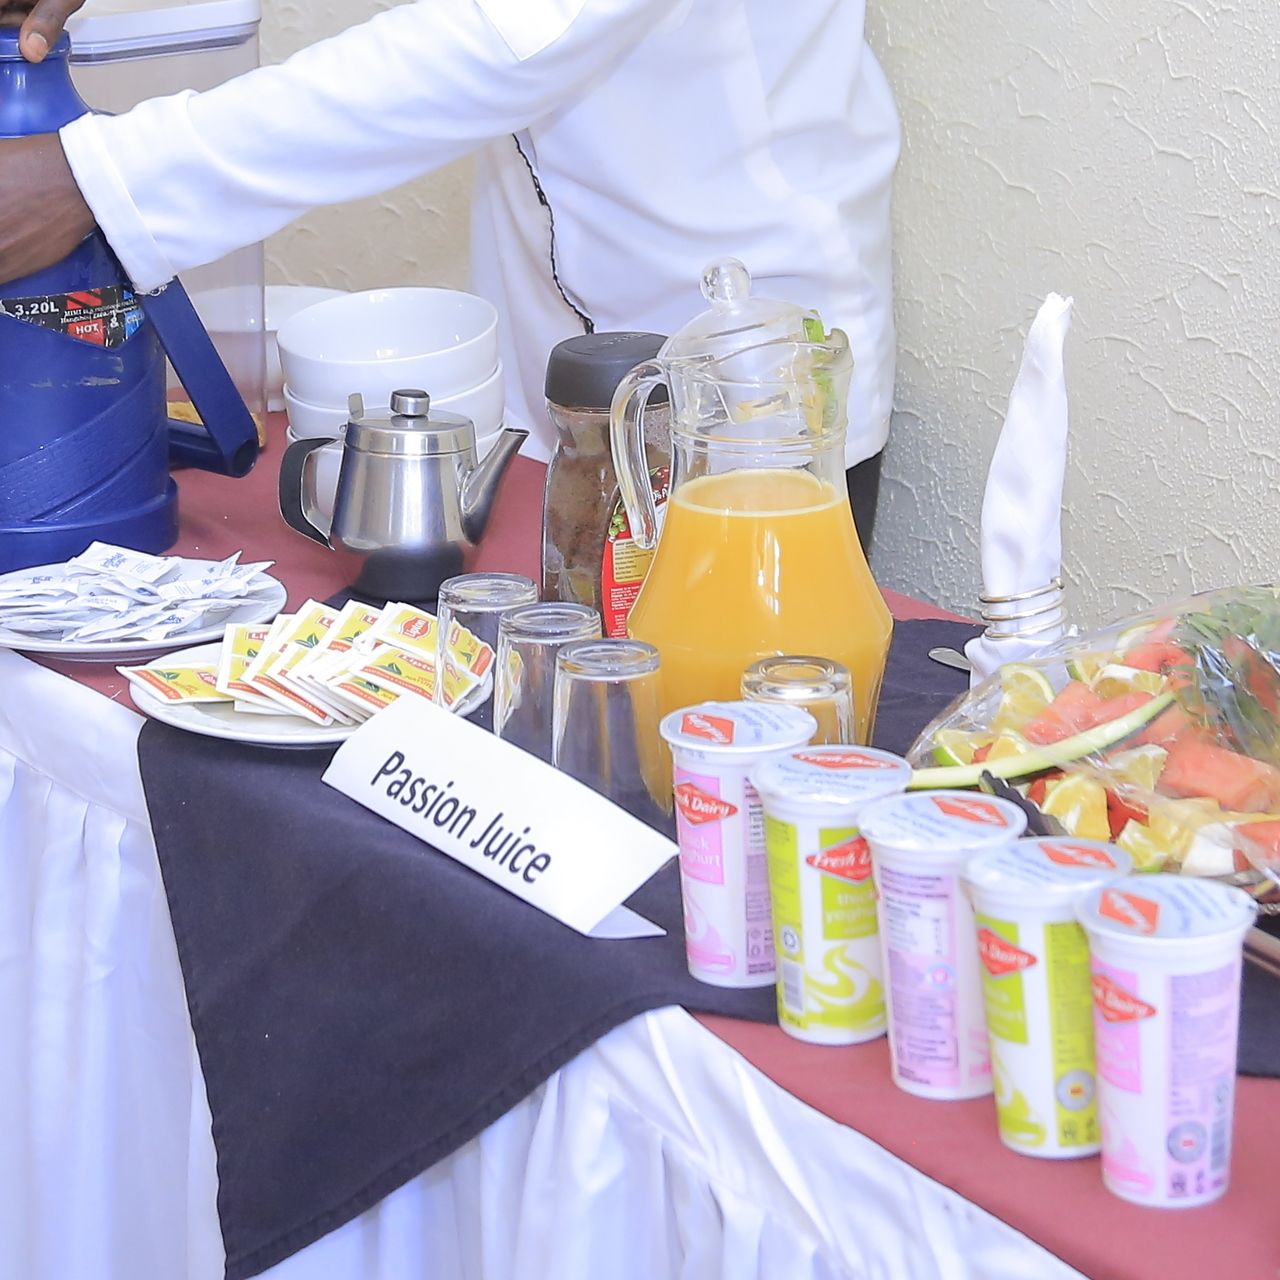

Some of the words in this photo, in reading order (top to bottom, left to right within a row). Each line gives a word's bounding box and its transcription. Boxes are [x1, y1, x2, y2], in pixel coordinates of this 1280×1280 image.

[14, 301, 60, 317] 3.20L
[76, 322, 99, 335] HOT
[404, 618, 427, 639] Lipton
[691, 796, 730, 817] Dairy
[370, 750, 477, 840] Passion
[469, 811, 552, 884] Juice
[814, 851, 856, 870] Fresh
